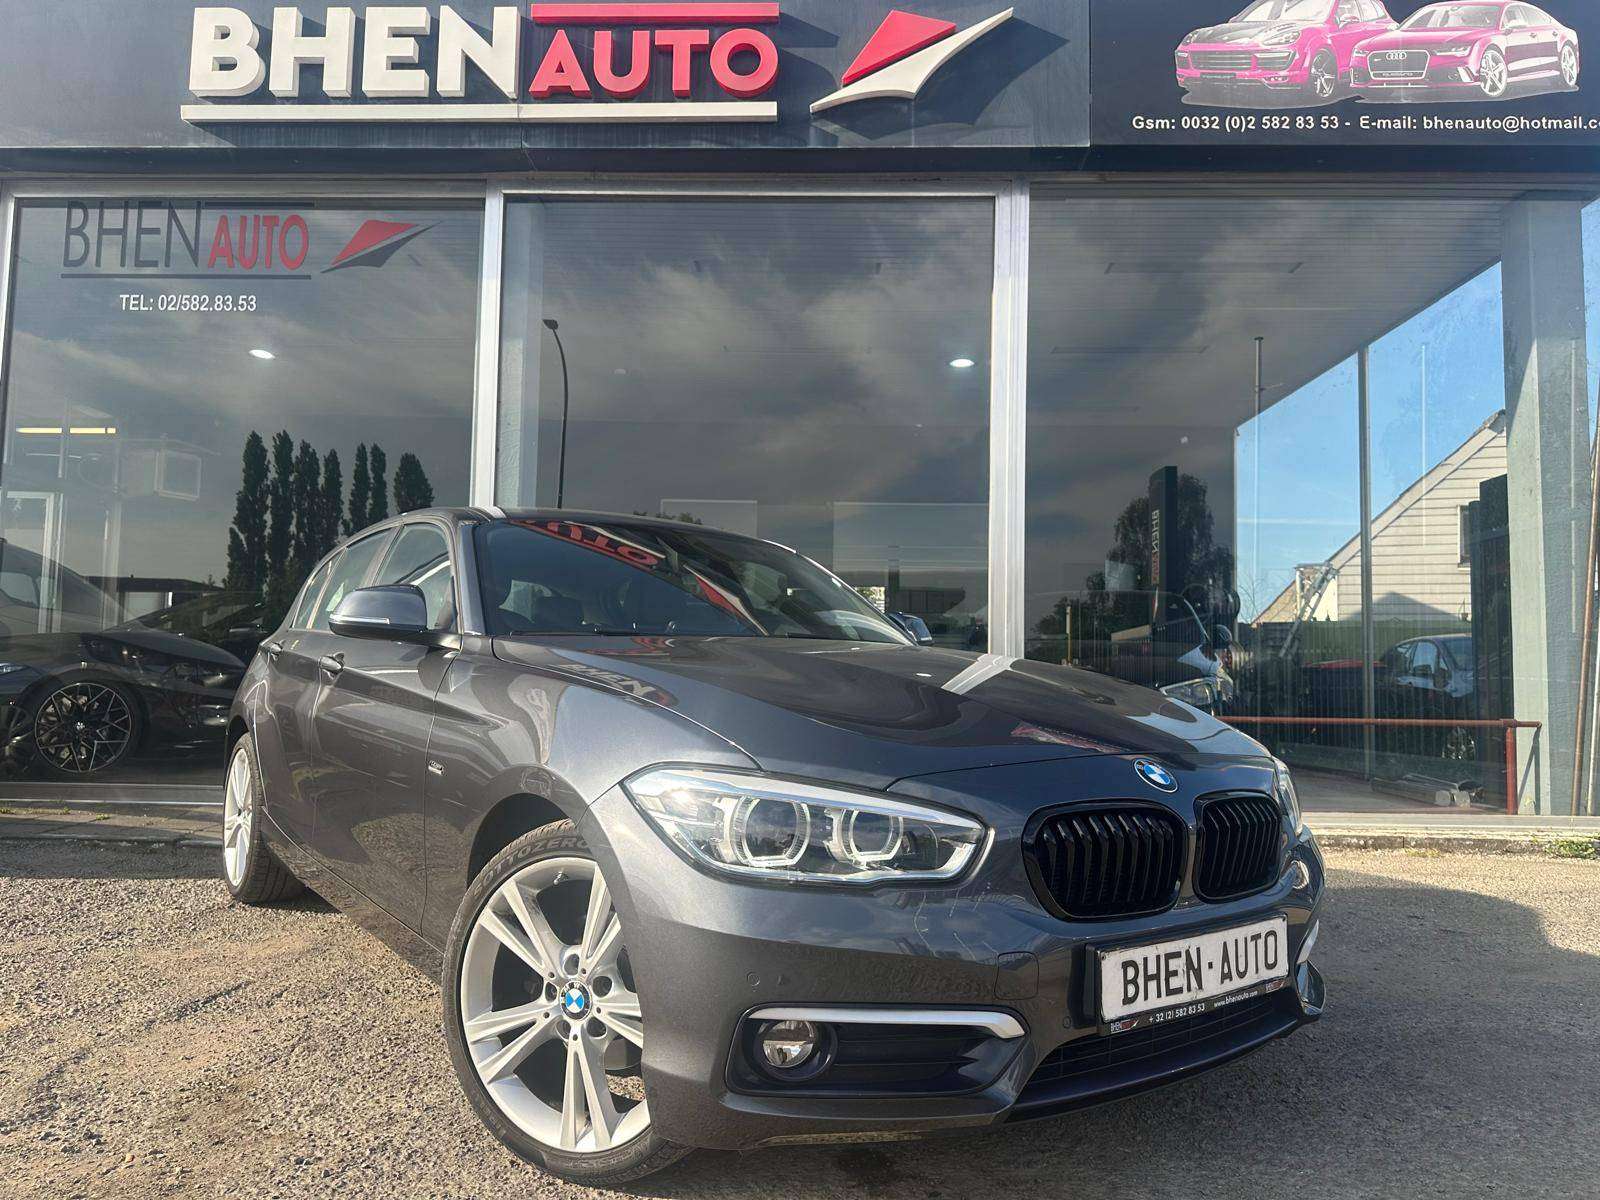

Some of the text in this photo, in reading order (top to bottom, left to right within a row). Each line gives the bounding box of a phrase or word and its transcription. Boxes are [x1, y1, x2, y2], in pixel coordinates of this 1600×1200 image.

[188, 6, 780, 99] BHEN AUTO
[1132, 115, 1175, 130] Gsm:
[1181, 115, 1220, 130] 0032
[1225, 114, 1256, 133] (0)2
[1262, 115, 1290, 130] 582
[1295, 115, 1315, 130] 83
[1320, 115, 1339, 130] 53
[1360, 115, 1417, 130] E-mail:
[1423, 115, 1600, 133] bhenauto@hotmail.c
[64, 201, 310, 271] BHEN AUTO
[120, 294, 257, 311] TEL: 02/582.83.53
[1155, 1013, 1164, 1022] 32
[1175, 1006, 1187, 1018] 582
[1188, 1005, 1196, 1015] 83
[1197, 1002, 1205, 1013] 53
